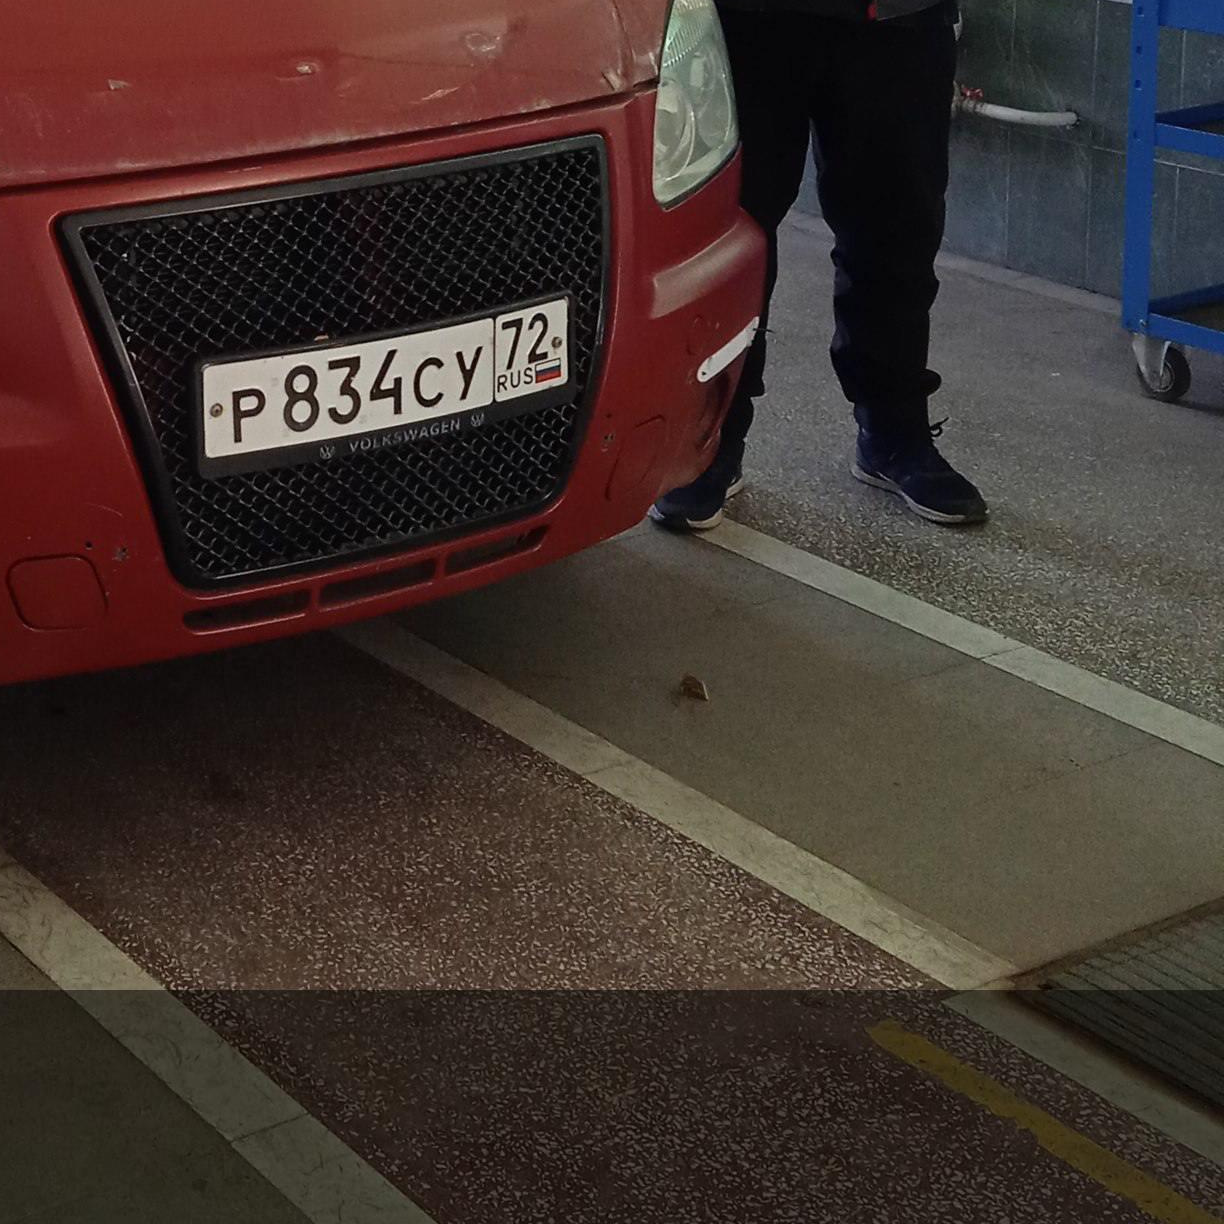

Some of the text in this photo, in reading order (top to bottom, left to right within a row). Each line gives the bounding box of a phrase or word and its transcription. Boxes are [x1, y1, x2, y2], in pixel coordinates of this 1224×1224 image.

[231, 312, 550, 444] Р834СУ 72
[496, 366, 535, 394] RUS
[348, 417, 462, 454] VOLKSWAGEN
